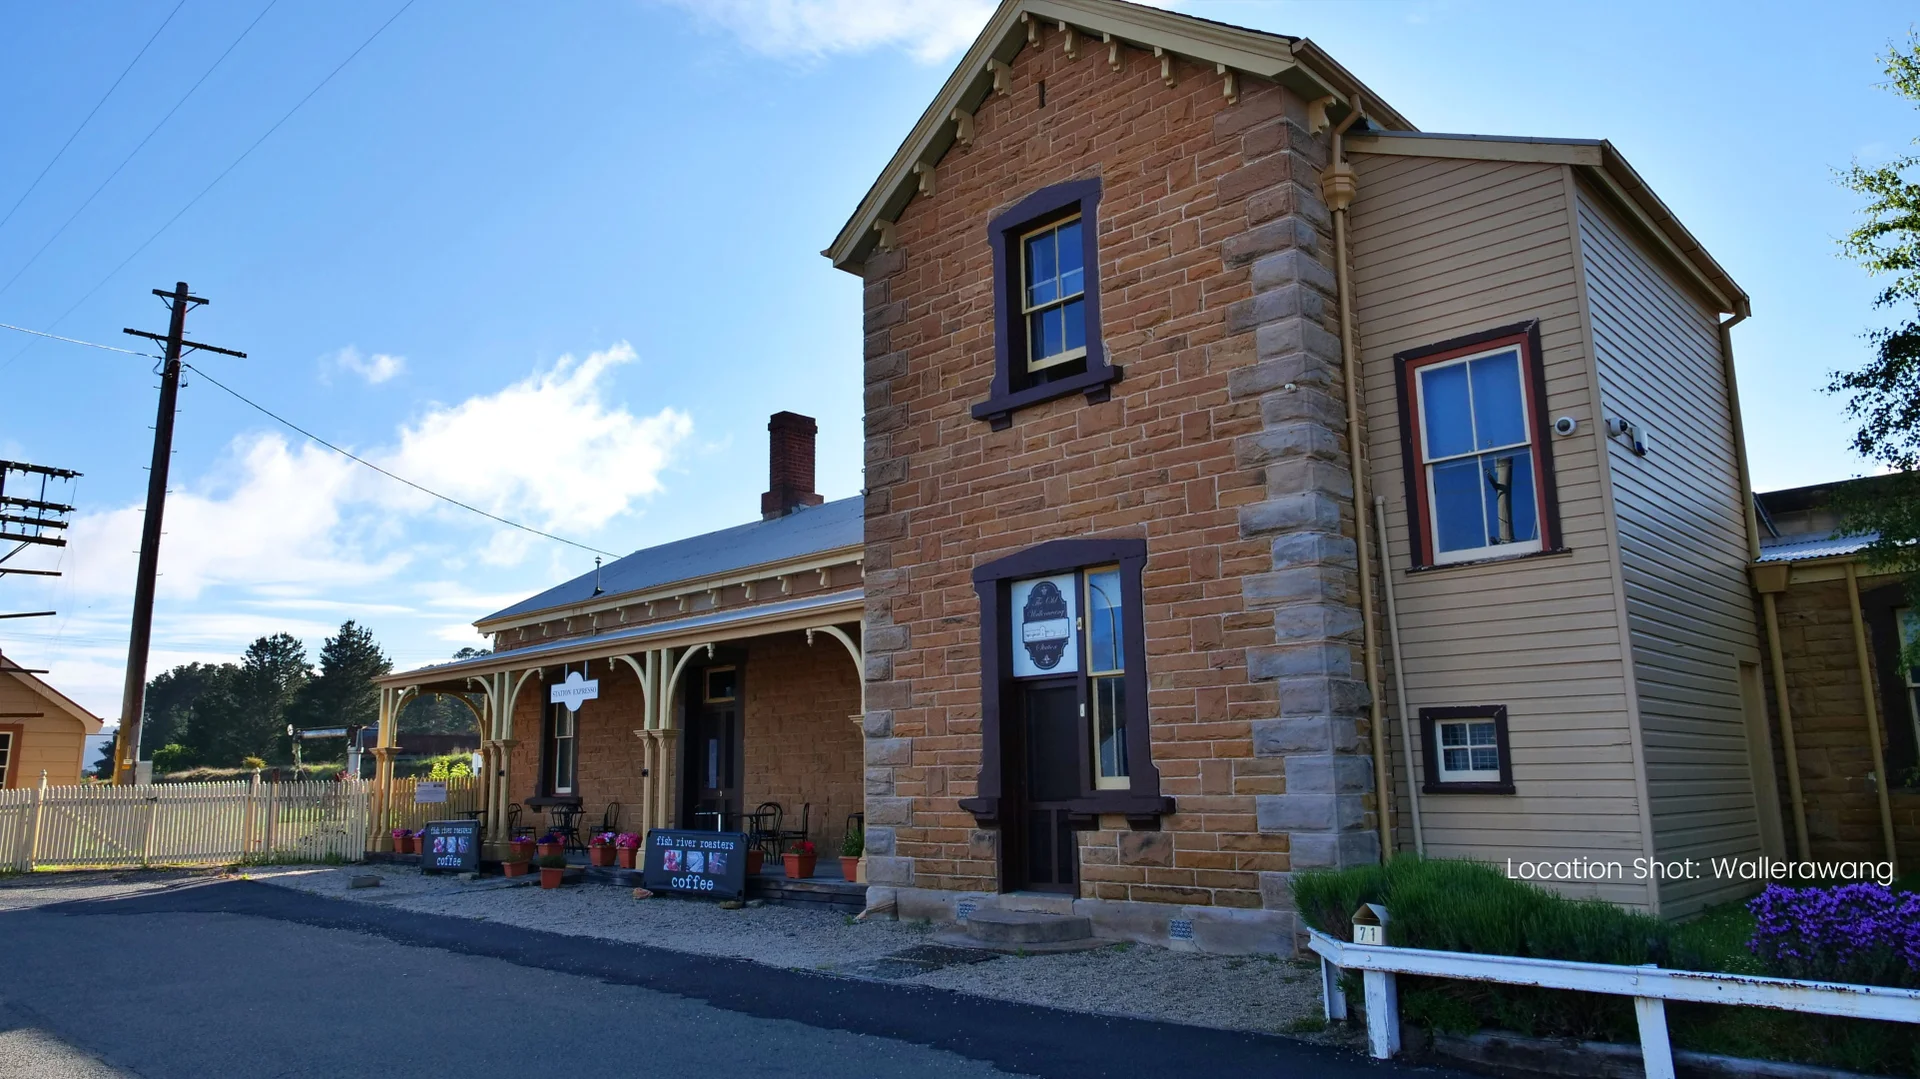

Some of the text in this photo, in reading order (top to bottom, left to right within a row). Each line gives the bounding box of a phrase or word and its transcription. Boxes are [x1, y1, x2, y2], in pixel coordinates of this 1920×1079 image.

[552, 687, 597, 697] STATION EXPRESSO
[656, 836, 734, 850] fish river roasters
[436, 854, 462, 867] coffee
[671, 874, 714, 891] coffee
[1360, 926, 1375, 942] 71
